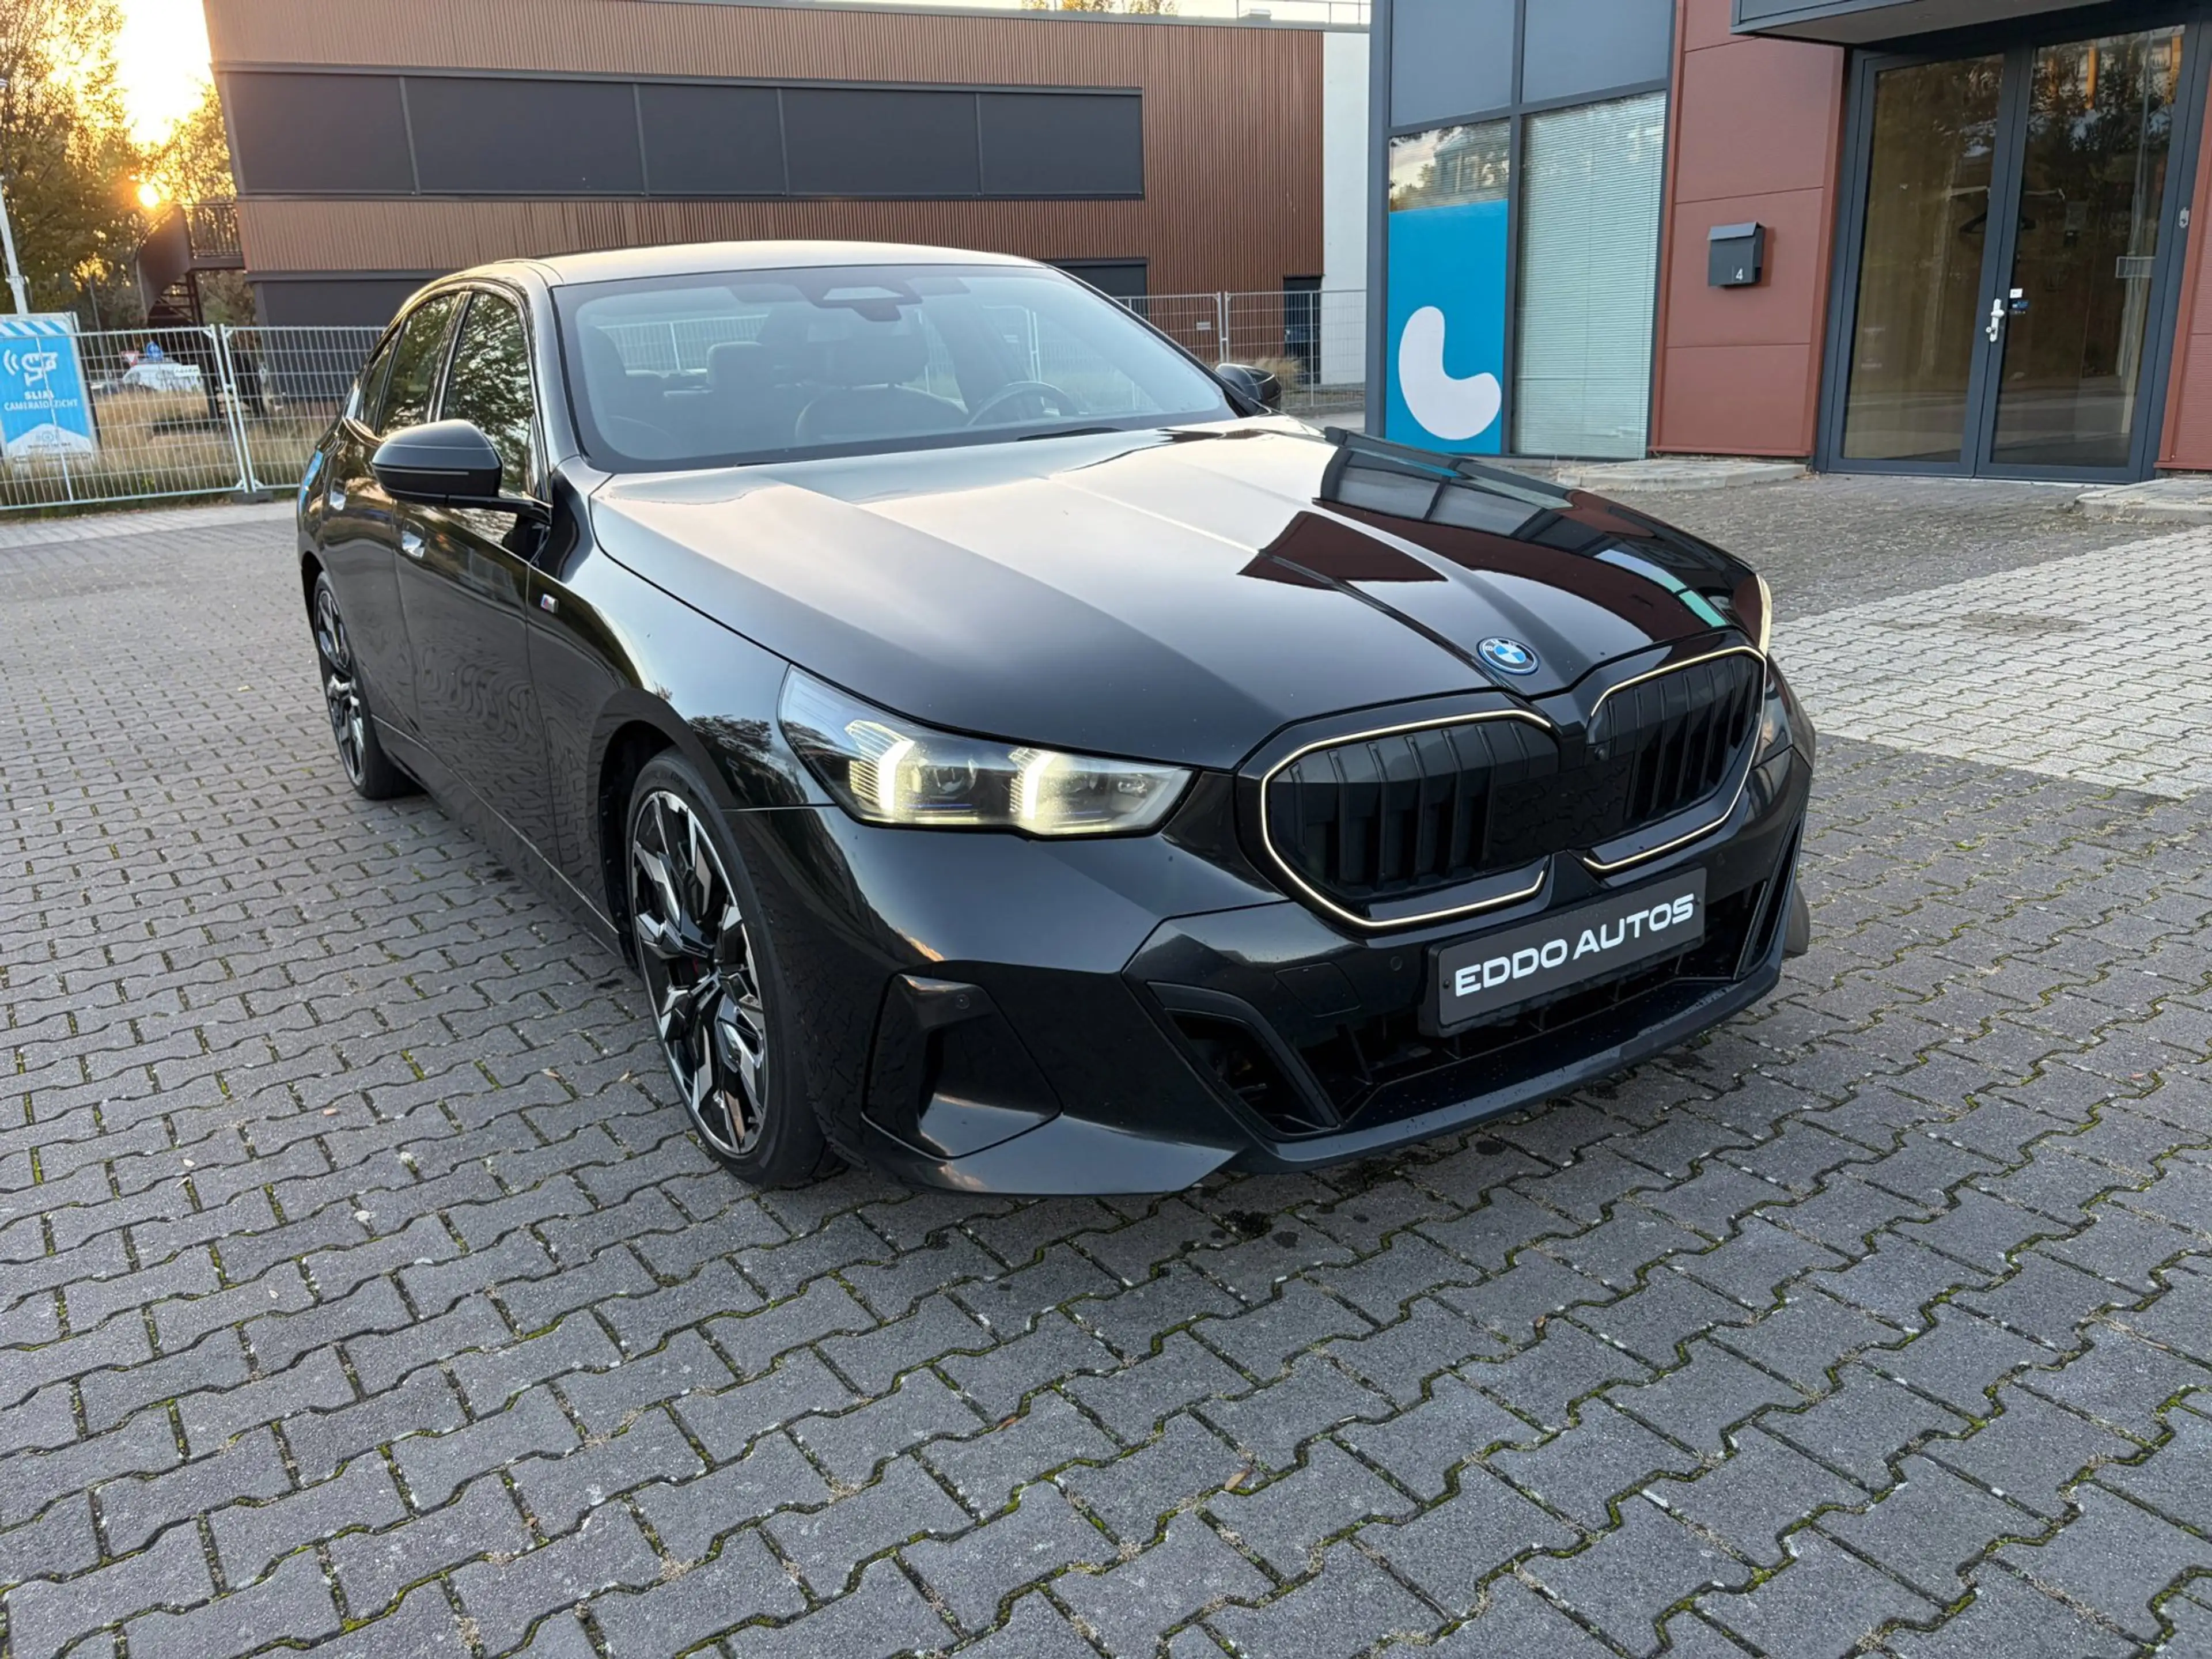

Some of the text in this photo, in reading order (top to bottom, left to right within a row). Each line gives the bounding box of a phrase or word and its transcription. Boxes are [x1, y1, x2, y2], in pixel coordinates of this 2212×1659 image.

[1736, 268, 1743, 280] 4
[4, 399, 78, 411] CAMERATOZICHT
[1455, 893, 1695, 997] EDDO AUTOS
